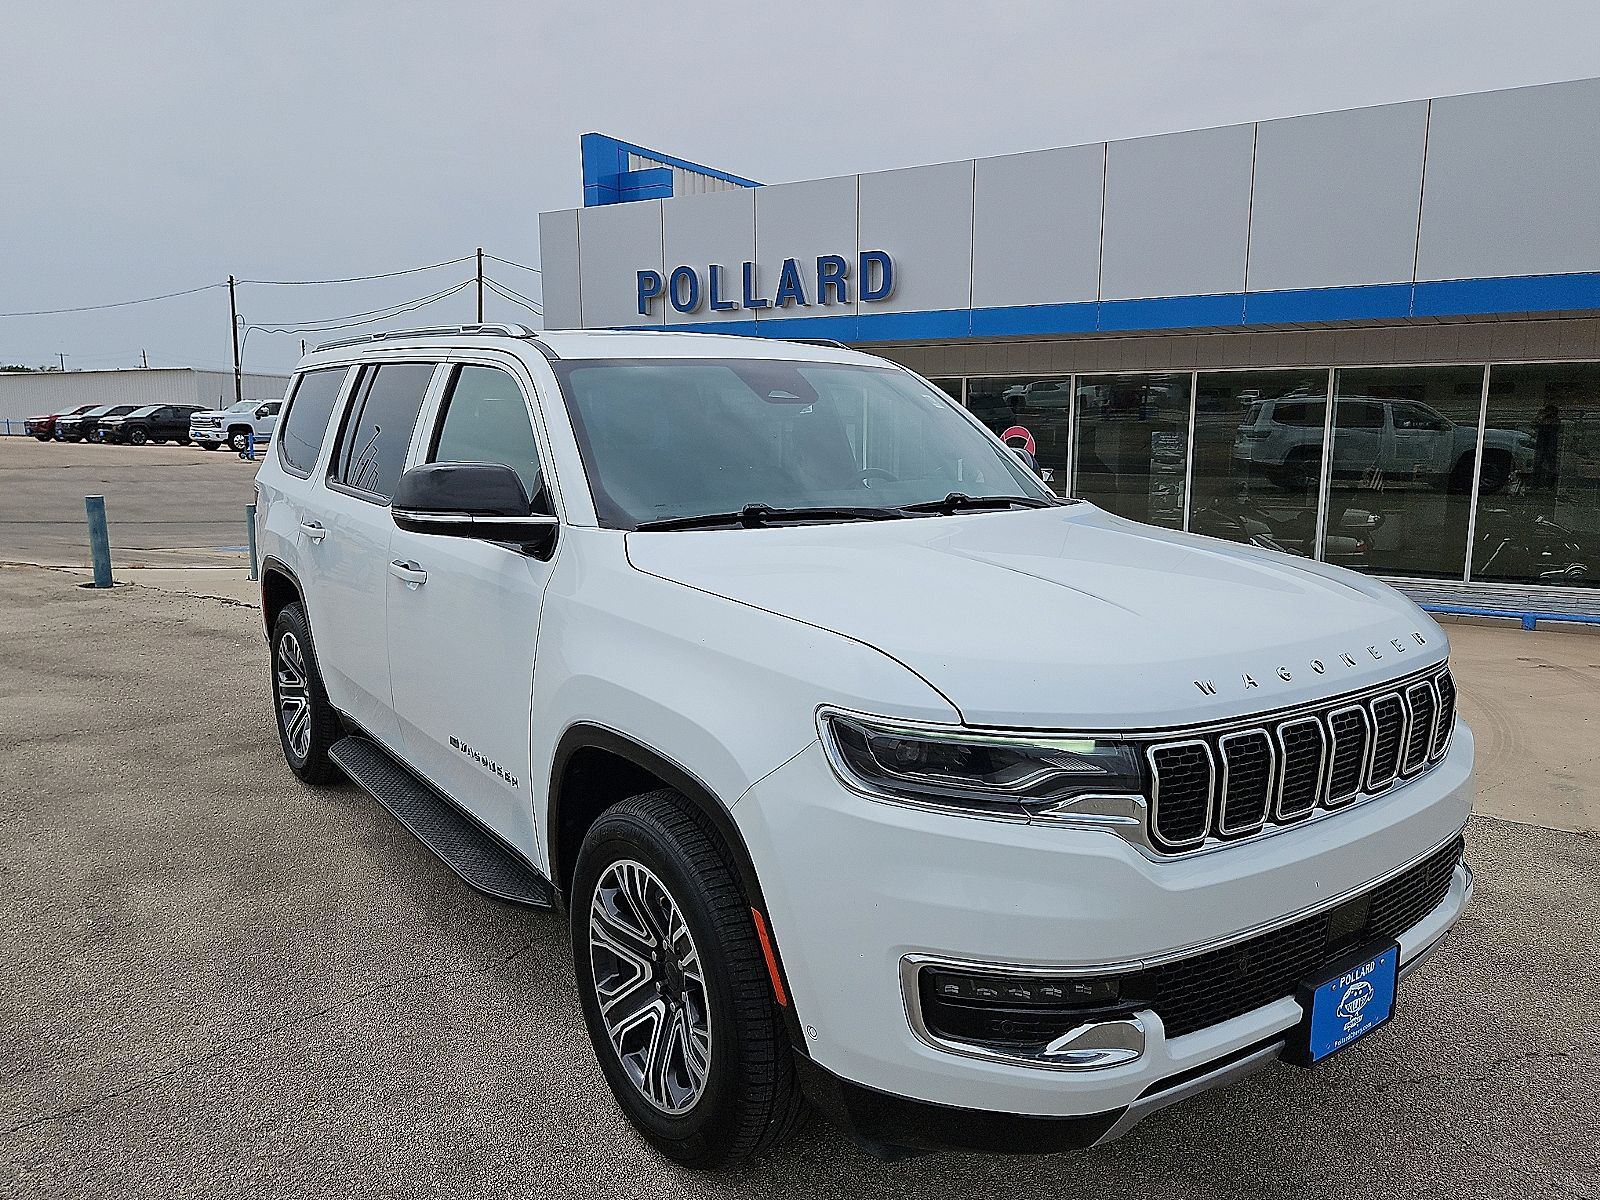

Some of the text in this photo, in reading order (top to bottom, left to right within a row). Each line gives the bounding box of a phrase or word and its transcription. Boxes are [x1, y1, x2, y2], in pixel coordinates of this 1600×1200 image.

[636, 249, 896, 315] POLLARD
[1193, 631, 1427, 696] WAGONEER
[1339, 961, 1376, 989] POLLARD
